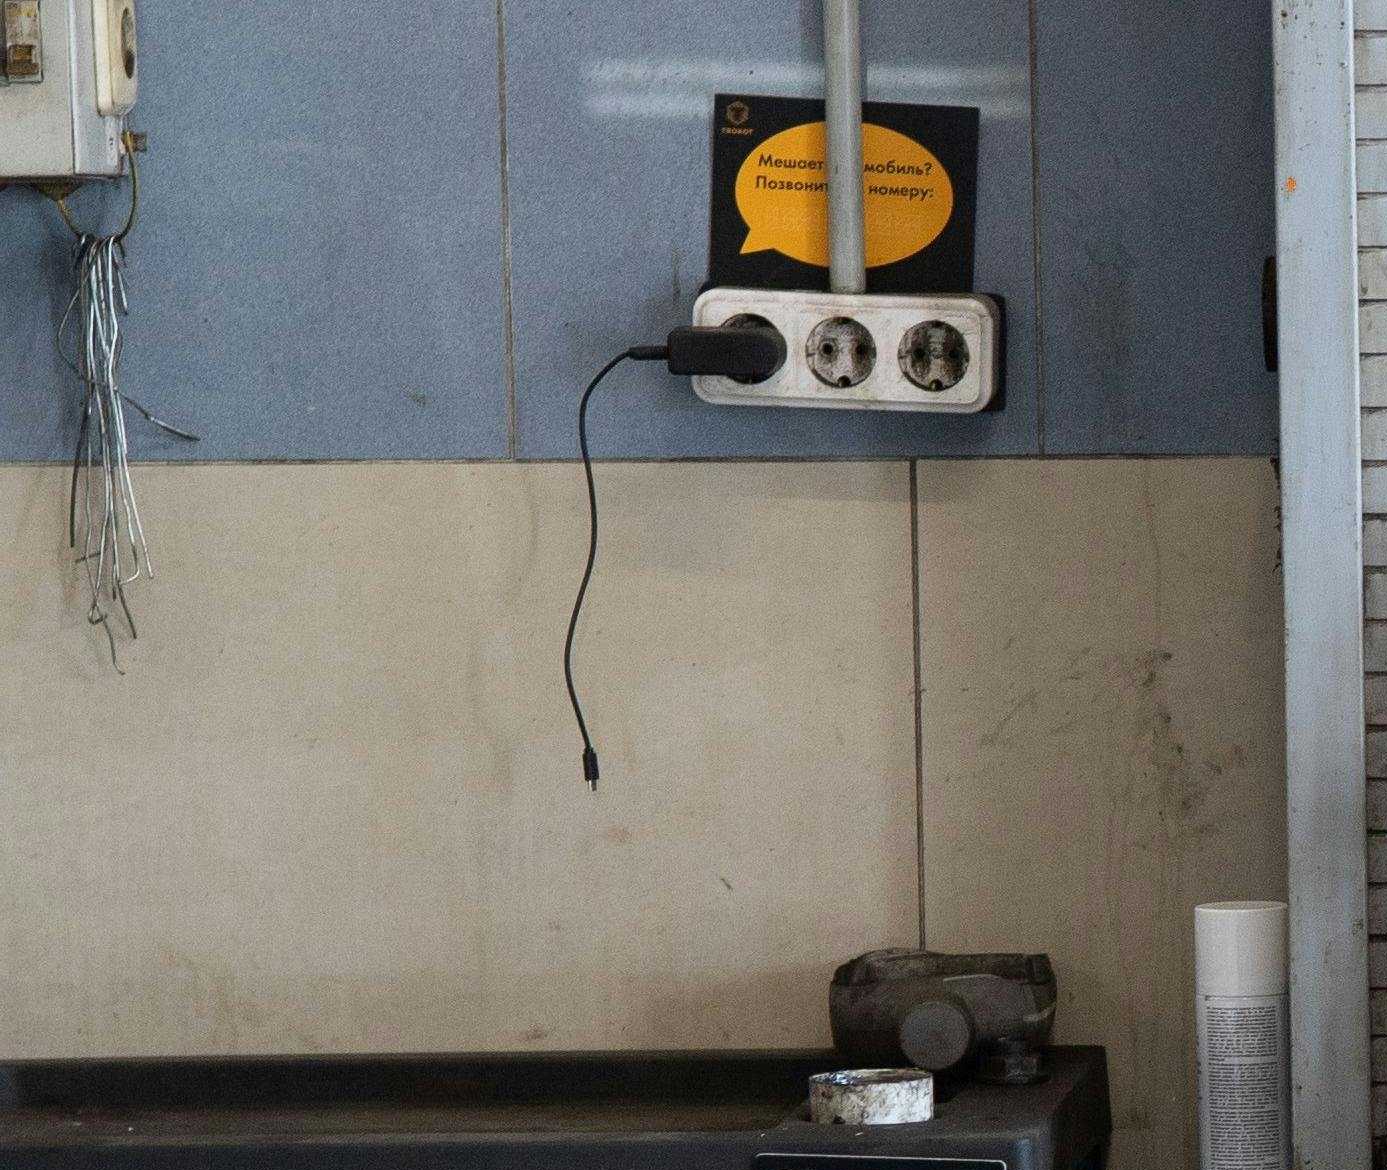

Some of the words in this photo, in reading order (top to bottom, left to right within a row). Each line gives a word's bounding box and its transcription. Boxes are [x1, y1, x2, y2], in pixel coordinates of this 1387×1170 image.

[758, 153, 824, 170] Мешает
[863, 159, 932, 176] мобиль?
[755, 175, 829, 193] Позвонит
[868, 184, 934, 202] номеру:
